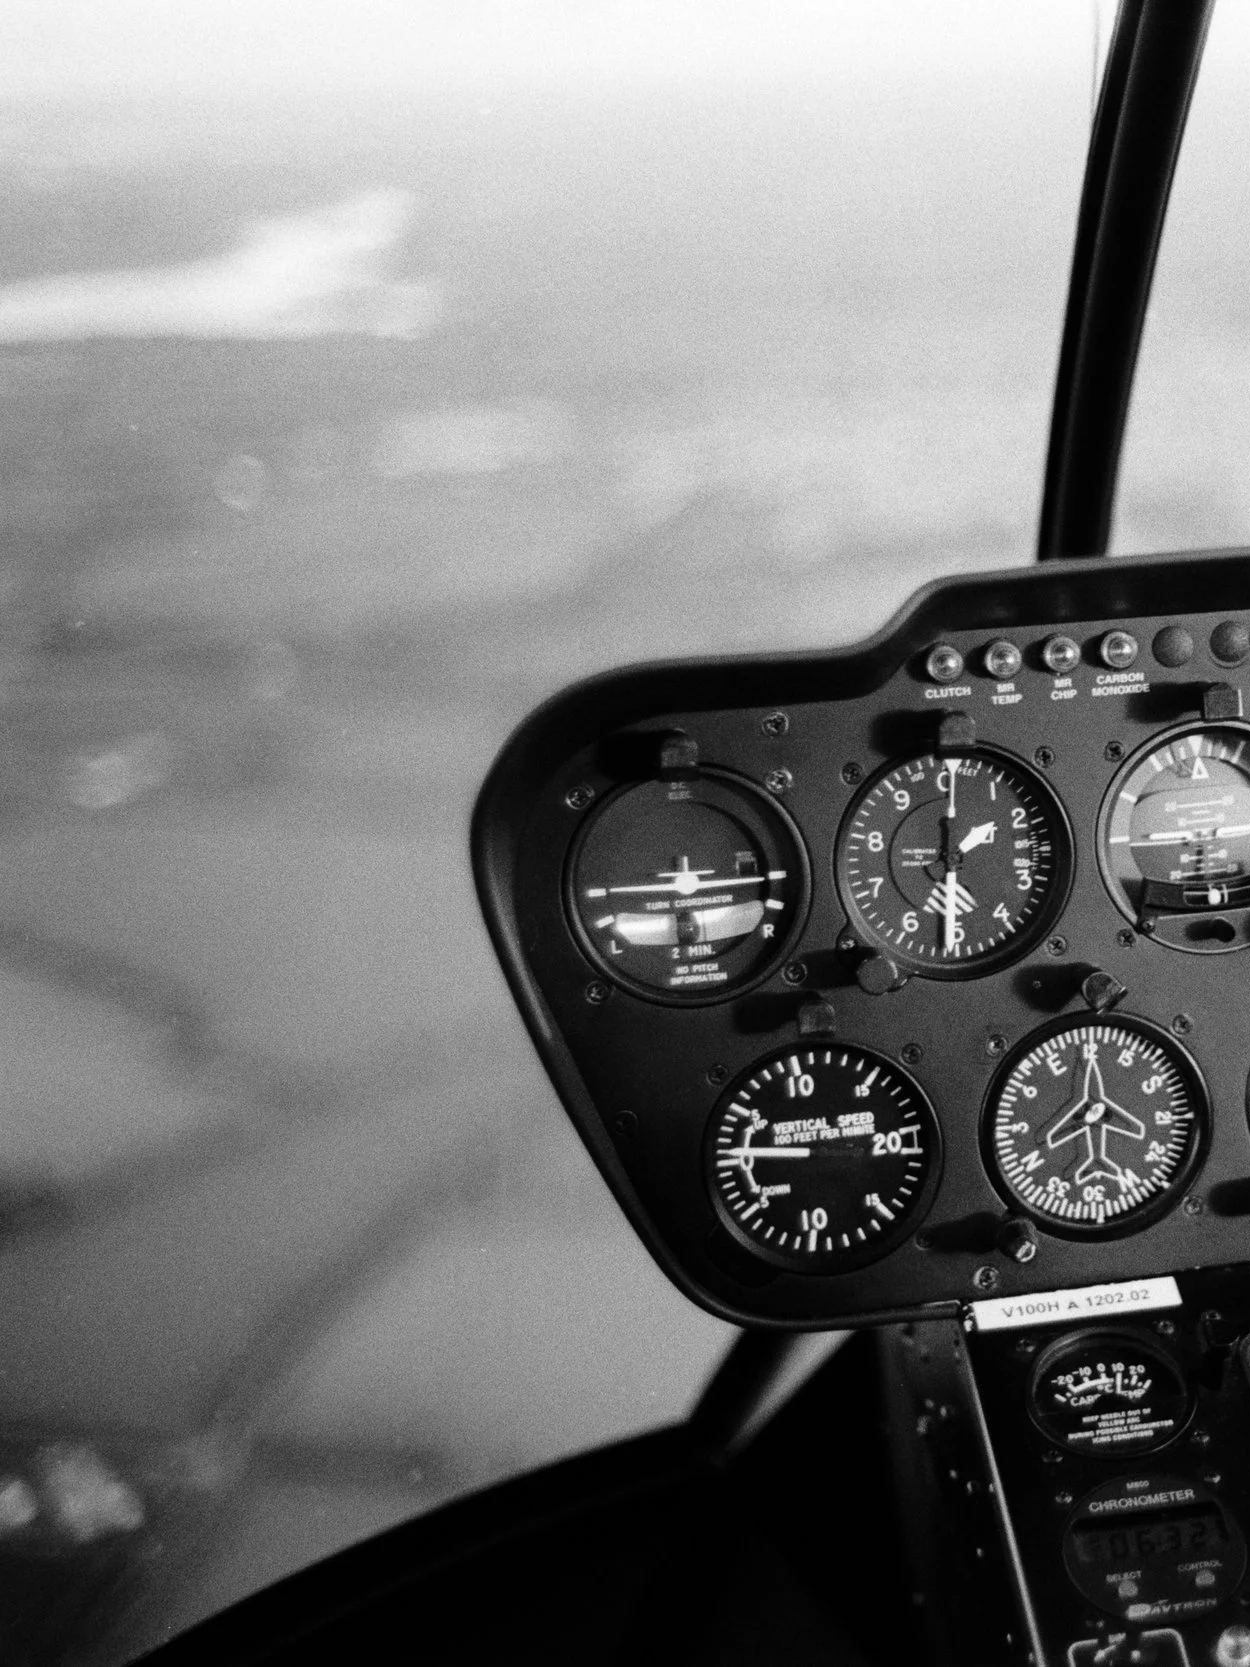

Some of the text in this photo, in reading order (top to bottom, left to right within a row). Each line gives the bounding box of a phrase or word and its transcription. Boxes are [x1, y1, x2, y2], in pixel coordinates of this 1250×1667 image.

[1054, 678, 1072, 688] MR
[1096, 672, 1145, 685] CARBON
[924, 686, 972, 699] CLUTCH
[996, 683, 1015, 693] MR
[1050, 689, 1078, 700] CHIP
[1091, 682, 1150, 697] MONOXIDE
[991, 694, 1023, 705] TEMP
[989, 781, 996, 801] 1
[893, 789, 911, 811] 9
[1011, 807, 1028, 829] 2
[867, 831, 884, 852] 8
[868, 877, 883, 898] 7
[1015, 869, 1032, 890] 3
[646, 894, 733, 911] TURN COORDINATOR
[992, 902, 1010, 923] 4
[902, 911, 919, 932] 6
[763, 923, 775, 939] R
[951, 921, 965, 943] 5
[610, 940, 623, 955] L
[671, 944, 716, 959] 2 MIN.
[676, 962, 719, 975] NO PITCH
[670, 972, 728, 986] INFORMATION
[1083, 1043, 1098, 1059] 12
[1118, 1049, 1134, 1067] 15
[1046, 1053, 1068, 1076] E
[788, 1074, 814, 1098] 10
[855, 1084, 871, 1097] 15
[1022, 1085, 1038, 1099] 6
[1141, 1075, 1163, 1095] S
[751, 1108, 761, 1121] 5
[773, 1111, 875, 1134] VERTICAL SPEED
[1154, 1110, 1172, 1125] 21
[754, 1119, 768, 1130] UP
[1013, 1121, 1029, 1134] 3
[774, 1124, 875, 1145] 100 FEET PER MINUTE
[872, 1131, 902, 1156] 20
[1144, 1140, 1166, 1162] 24
[1020, 1150, 1045, 1173] N
[1045, 1176, 1071, 1198] 33
[1119, 1167, 1141, 1193] W
[762, 1184, 791, 1196] DOWN
[1082, 1184, 1106, 1201] 30
[760, 1196, 770, 1209] 5
[865, 1193, 881, 1207] 15
[801, 1207, 828, 1232] 10
[1002, 1289, 1150, 1318] V100H A 1202.02
[1072, 1366, 1092, 1377] -10
[1096, 1363, 1106, 1373] 0
[1111, 1362, 1125, 1373] 10
[1128, 1364, 1146, 1375] 20
[1051, 1374, 1074, 1386] -20
[1088, 1489, 1196, 1512] CHRONOMETER
